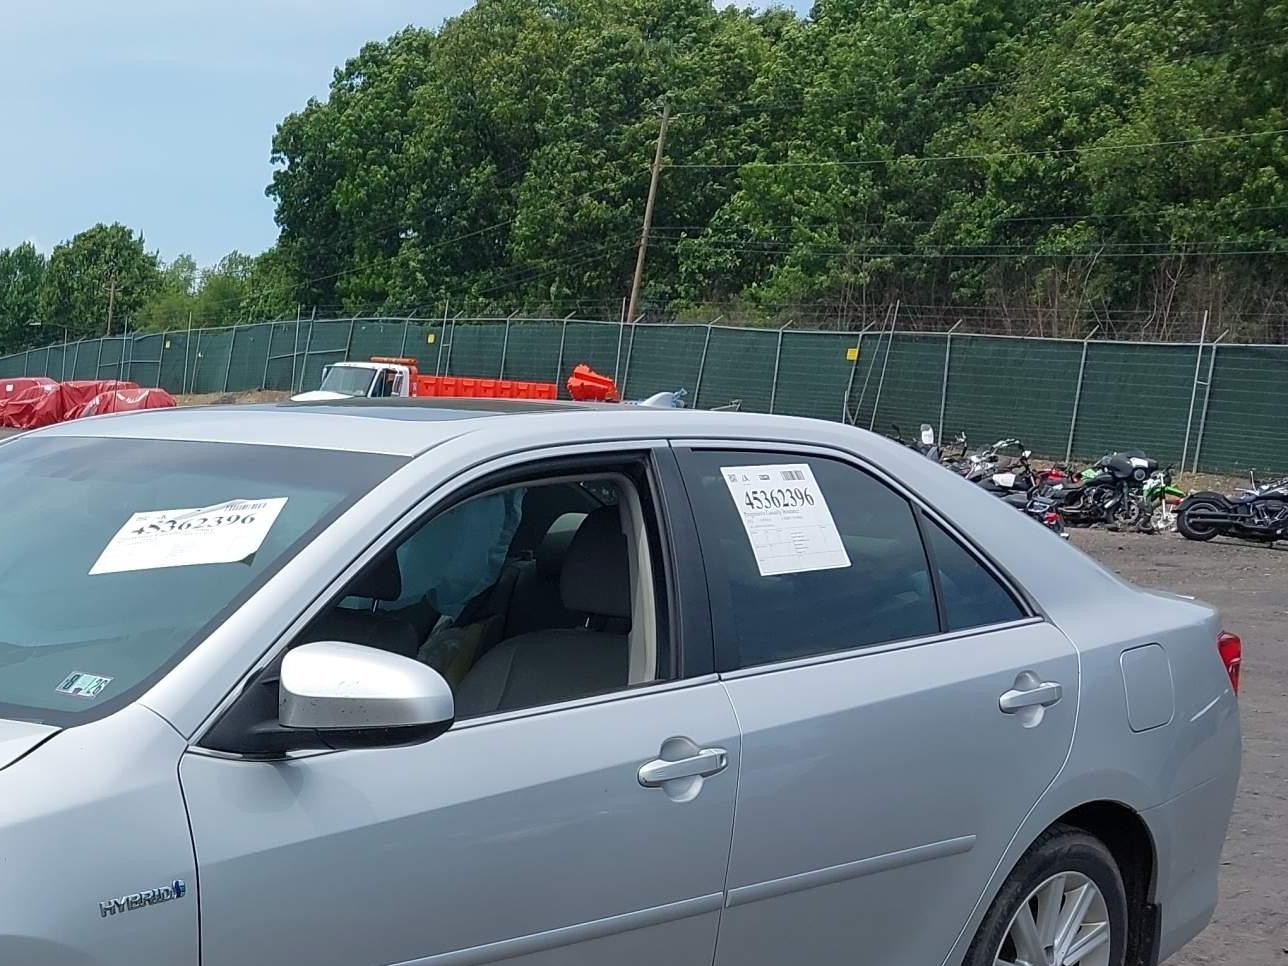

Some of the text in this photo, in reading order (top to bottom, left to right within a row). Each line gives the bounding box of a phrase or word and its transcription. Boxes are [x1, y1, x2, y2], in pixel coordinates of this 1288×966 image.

[745, 487, 815, 510] 45362396
[132, 513, 256, 535] 45362396
[99, 886, 173, 918] HYBRID
